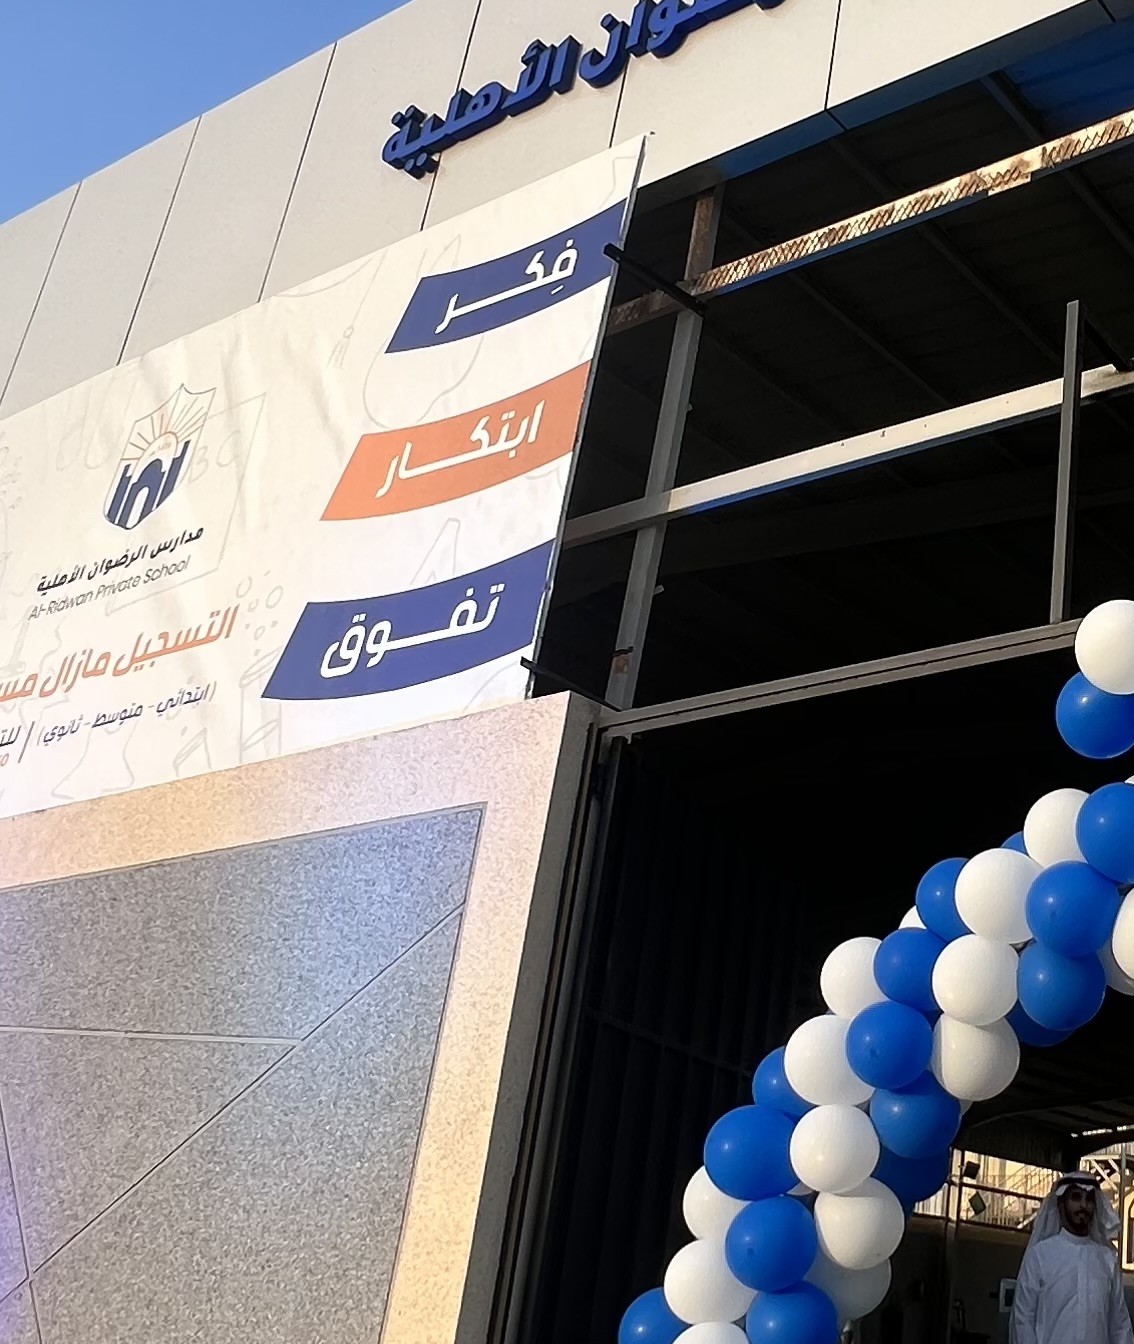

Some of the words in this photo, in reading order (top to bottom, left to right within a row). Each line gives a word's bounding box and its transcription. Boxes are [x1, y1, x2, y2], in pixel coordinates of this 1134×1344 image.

[381, 34, 582, 180] الأهلية
[87, 544, 148, 582] الرضوان
[149, 526, 205, 560] مدارس
[27, 590, 94, 622] Al-Ridwan
[94, 574, 142, 602] Private
[142, 554, 192, 585] School
[36, 564, 87, 597] الأهلية
[112, 603, 241, 677] التسجيل
